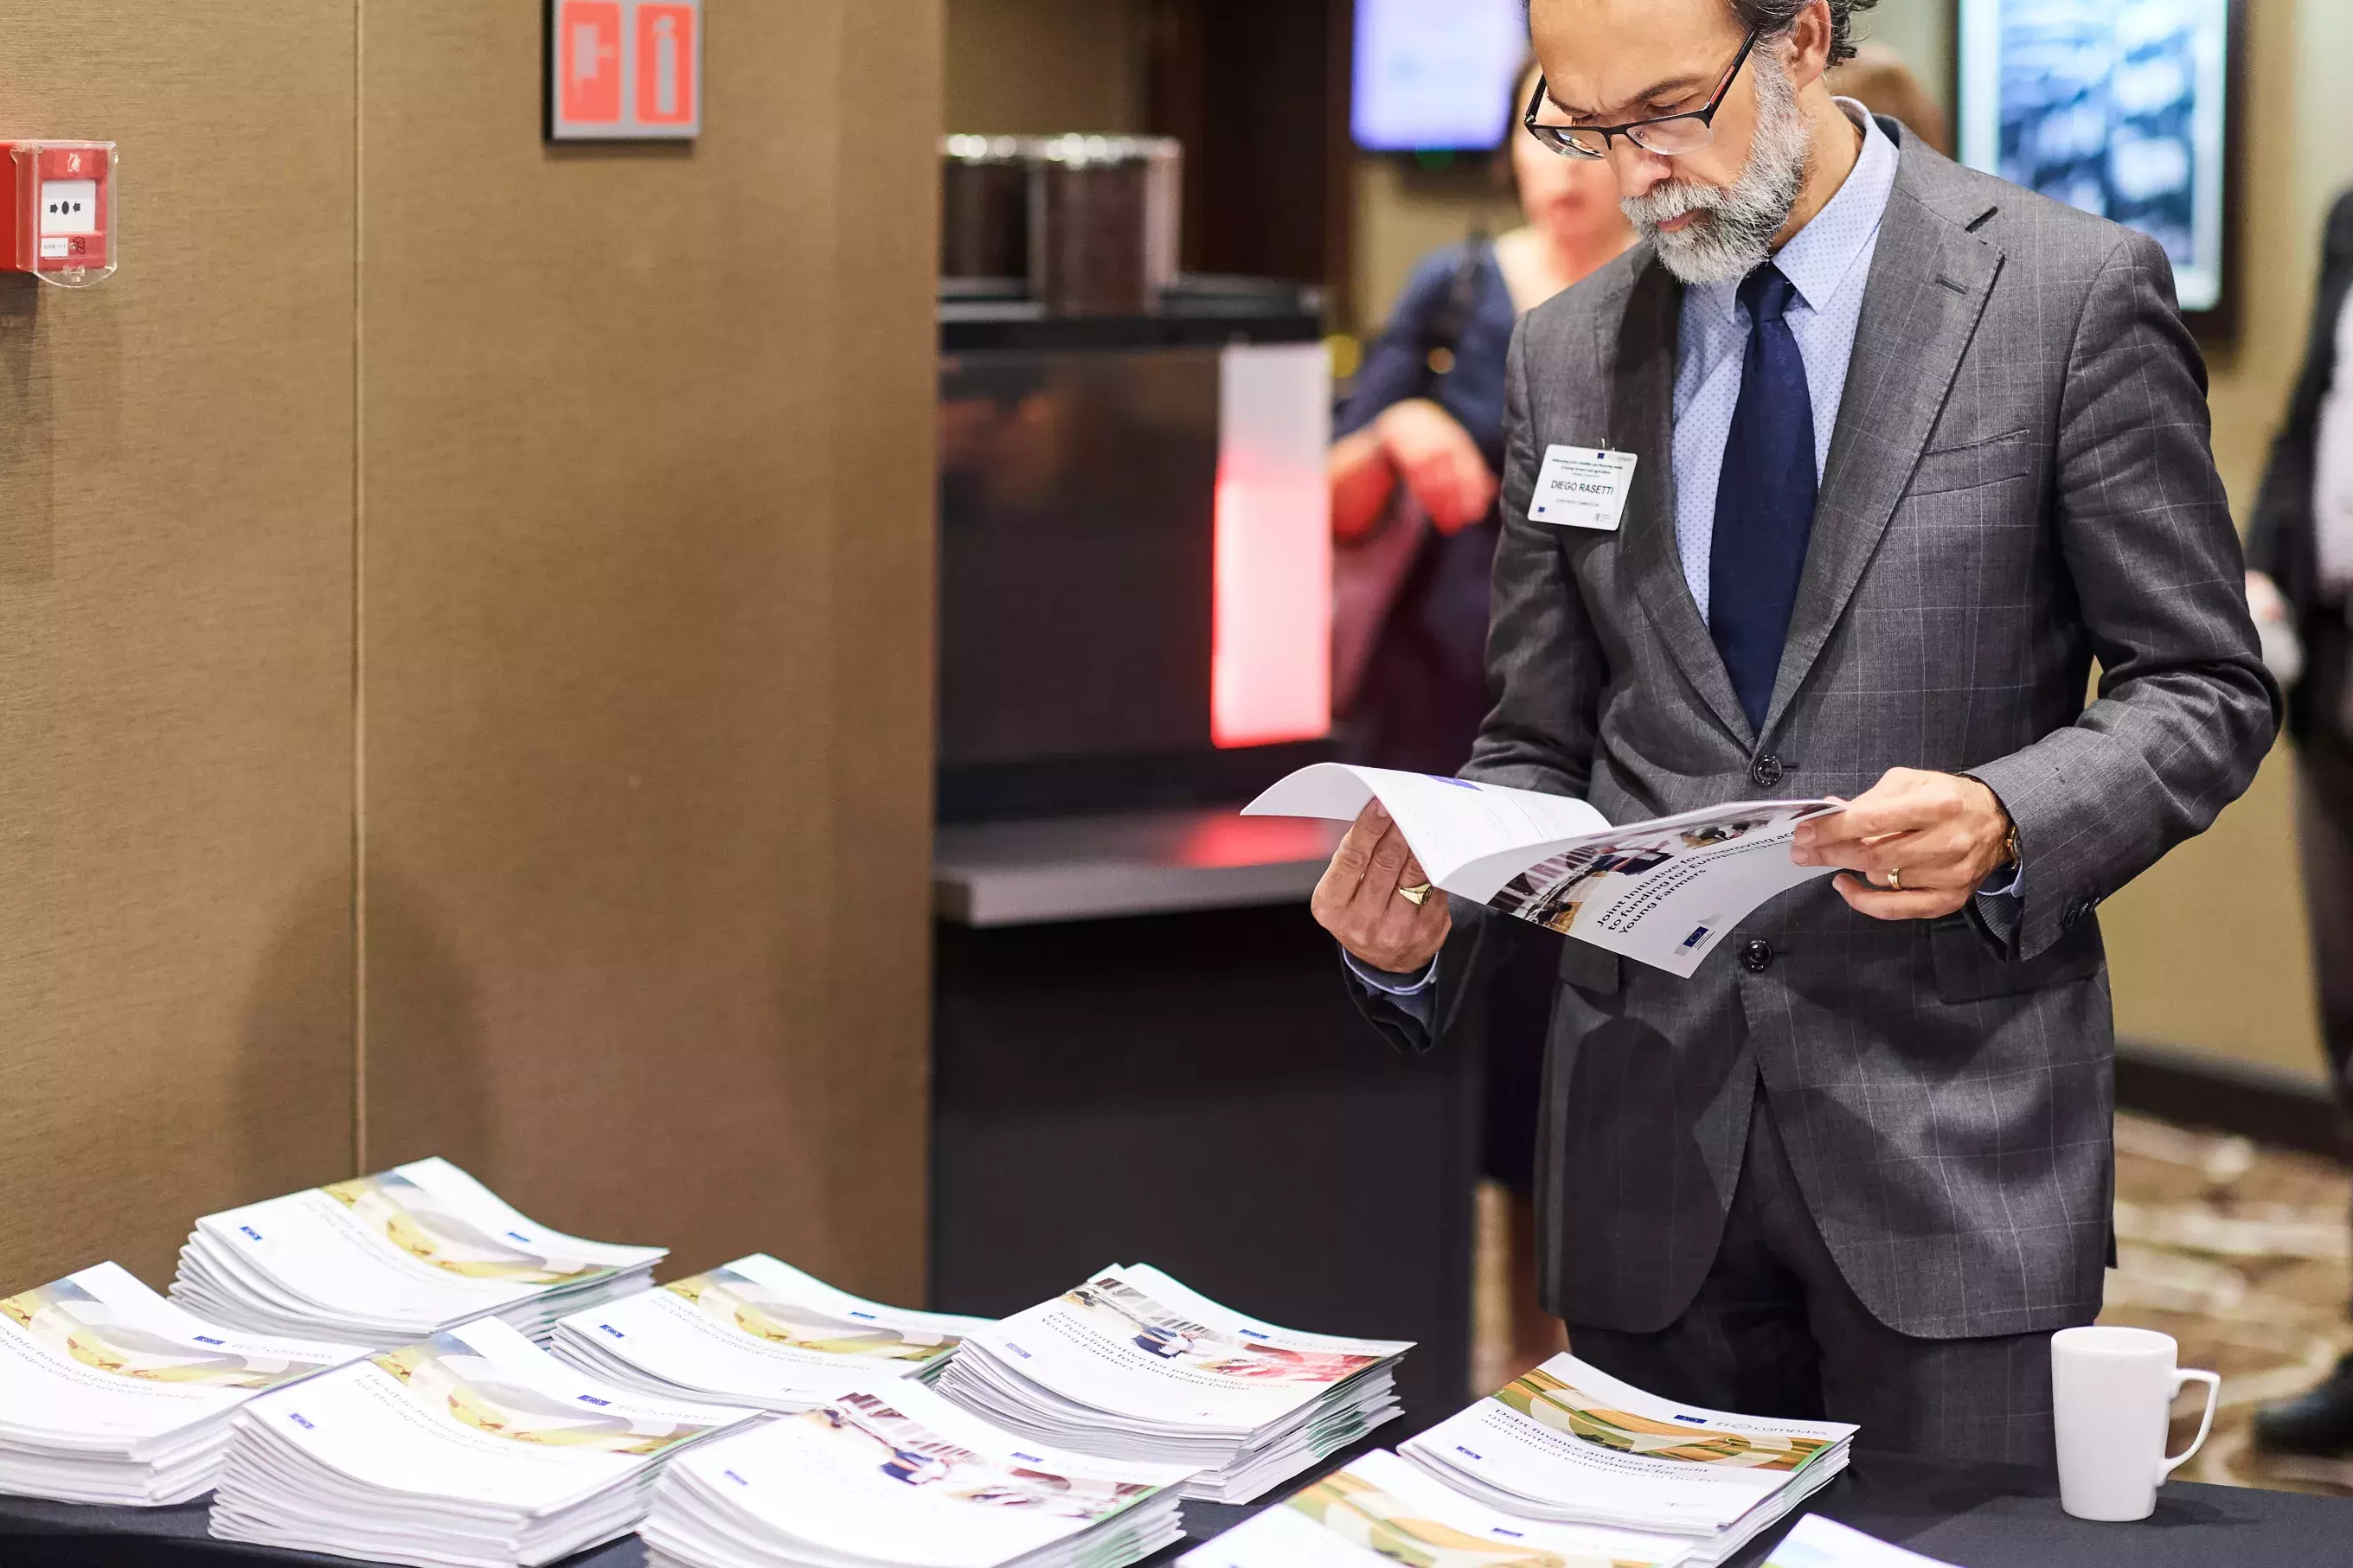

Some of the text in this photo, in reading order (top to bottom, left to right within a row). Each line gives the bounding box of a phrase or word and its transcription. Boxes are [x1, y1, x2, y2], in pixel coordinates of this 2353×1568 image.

[1551, 480, 1614, 496] DIEGO RASETTI
[1596, 899, 1626, 927] Joint
[1625, 865, 1682, 899] Initiative
[1680, 854, 1702, 867] for
[1703, 835, 1775, 857] improving
[1607, 918, 1622, 931] to
[1619, 880, 1671, 919] funding
[1668, 868, 1689, 883] for
[1689, 848, 1754, 870] European
[1618, 869, 1707, 934] Young Farmers
[0, 1325, 35, 1351] exible
[35, 1351, 93, 1379] financial
[1041, 1316, 1135, 1371] Young Farmers
[1048, 1313, 1249, 1391] to funding for European Union
[1055, 1310, 1088, 1332] Joint
[1088, 1329, 1147, 1361] Initiative
[1148, 1360, 1170, 1370] for
[1480, 1418, 1562, 1458] agricultural
[1563, 1456, 1646, 1478] enterprises
[1488, 1413, 1561, 1451] guarantee
[1562, 1448, 1650, 1474] instruments
[1495, 1408, 1529, 1430] Debt
[1531, 1427, 1584, 1453] finance
[1586, 1450, 1616, 1462] and
[1619, 1456, 1645, 1467] use
[1664, 1465, 1709, 1474] credit
[1754, 1427, 1828, 1437] compass
